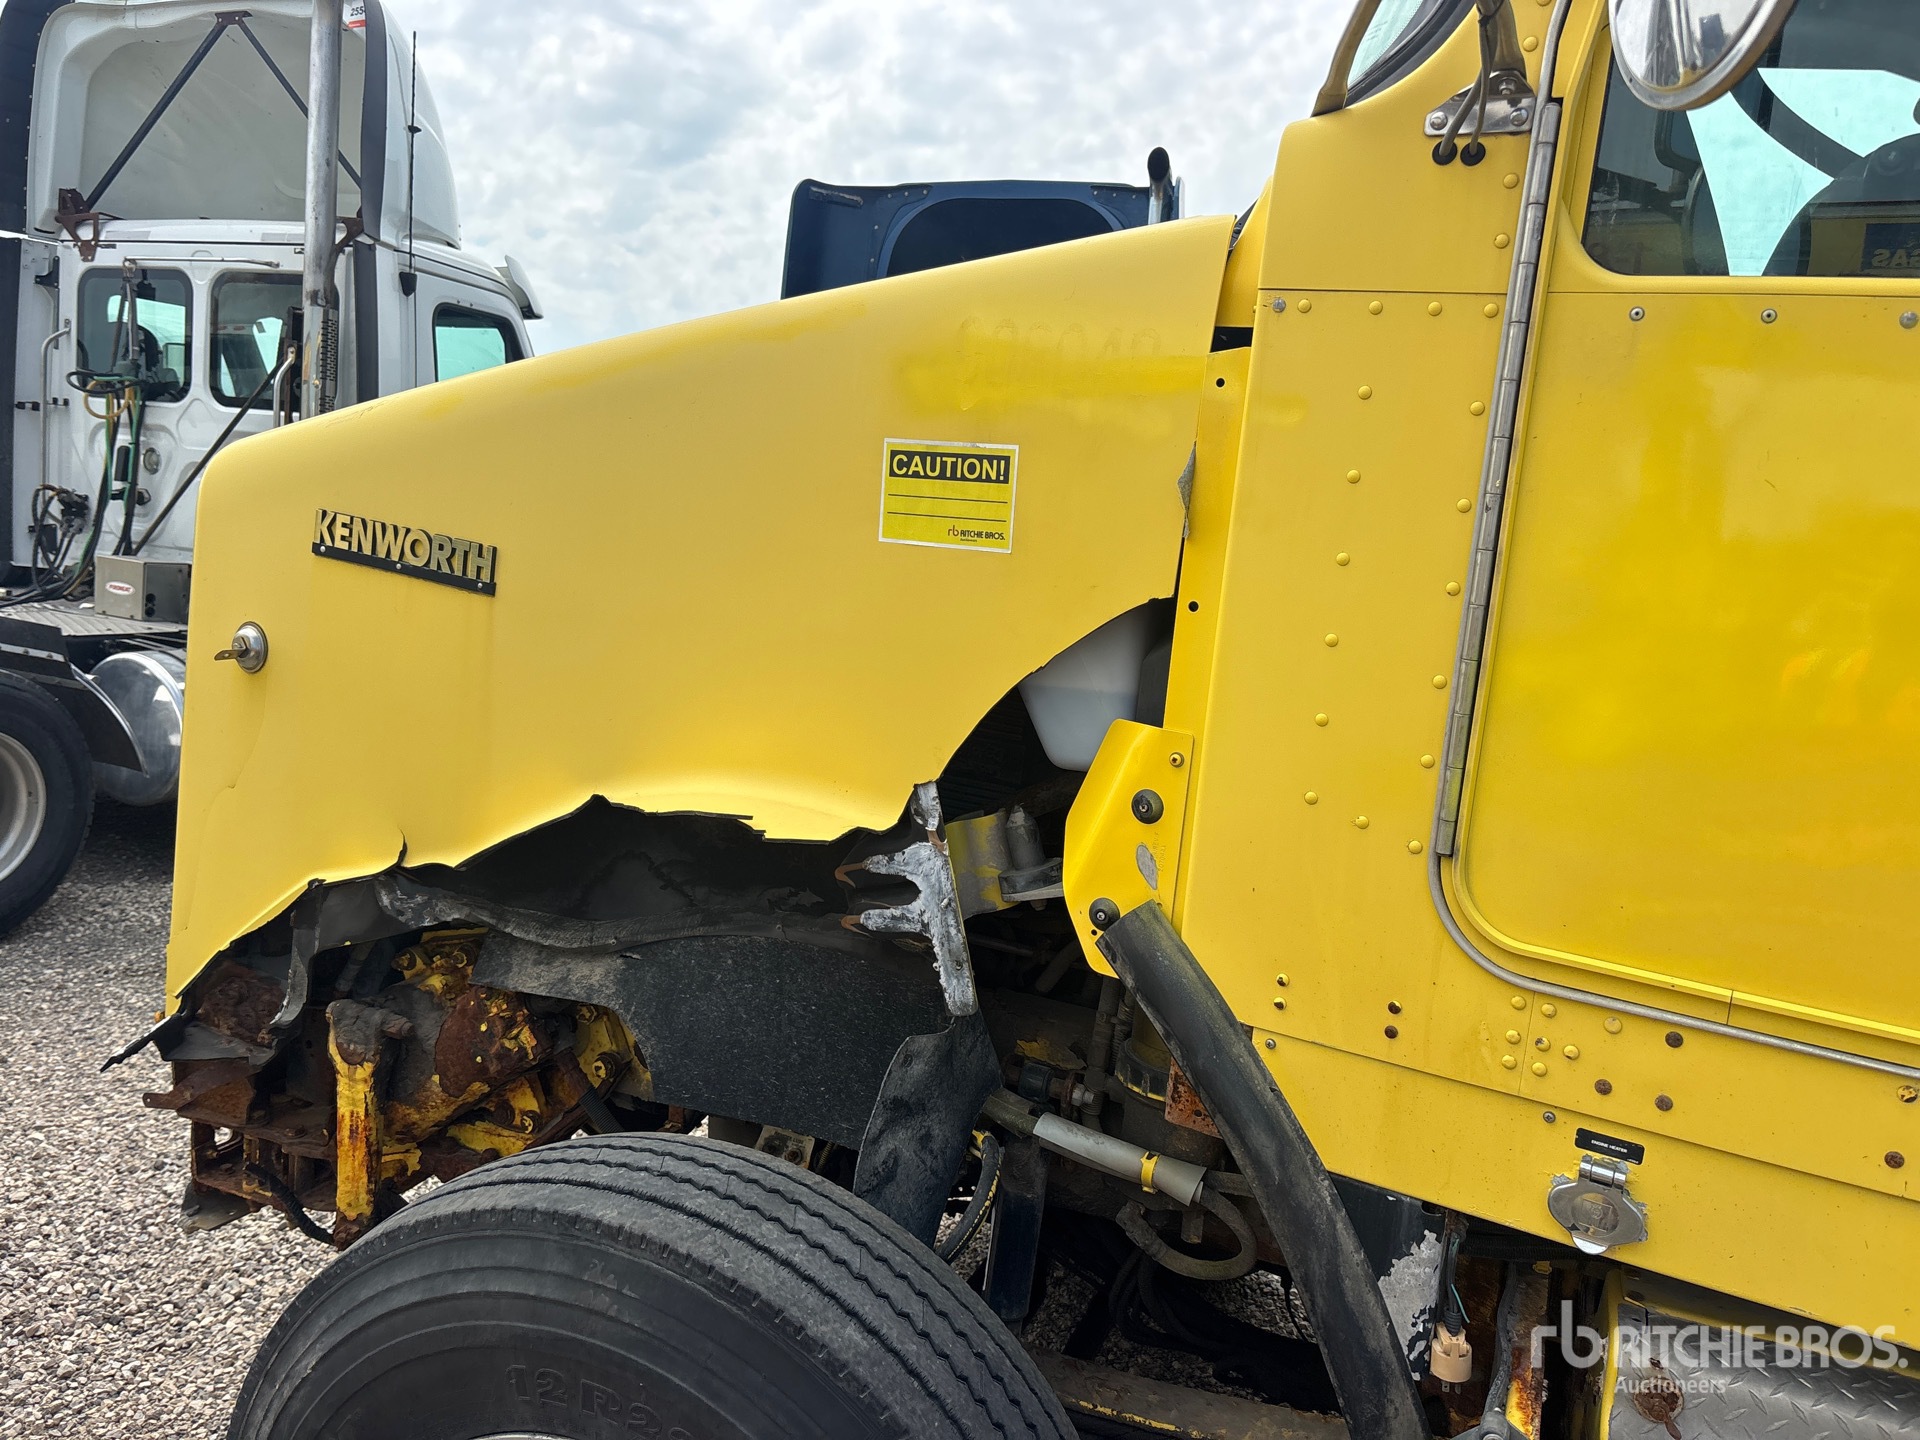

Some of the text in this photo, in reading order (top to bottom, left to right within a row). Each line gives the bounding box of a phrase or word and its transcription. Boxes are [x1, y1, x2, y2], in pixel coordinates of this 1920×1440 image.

[350, 5, 366, 17] 255
[892, 454, 1005, 481] CAUTION!
[960, 529, 984, 539] RITCHIE
[985, 531, 1006, 541] BROS.
[314, 508, 497, 583] KENWORTH
[1590, 1139, 1628, 1154] ENGINE HEATER
